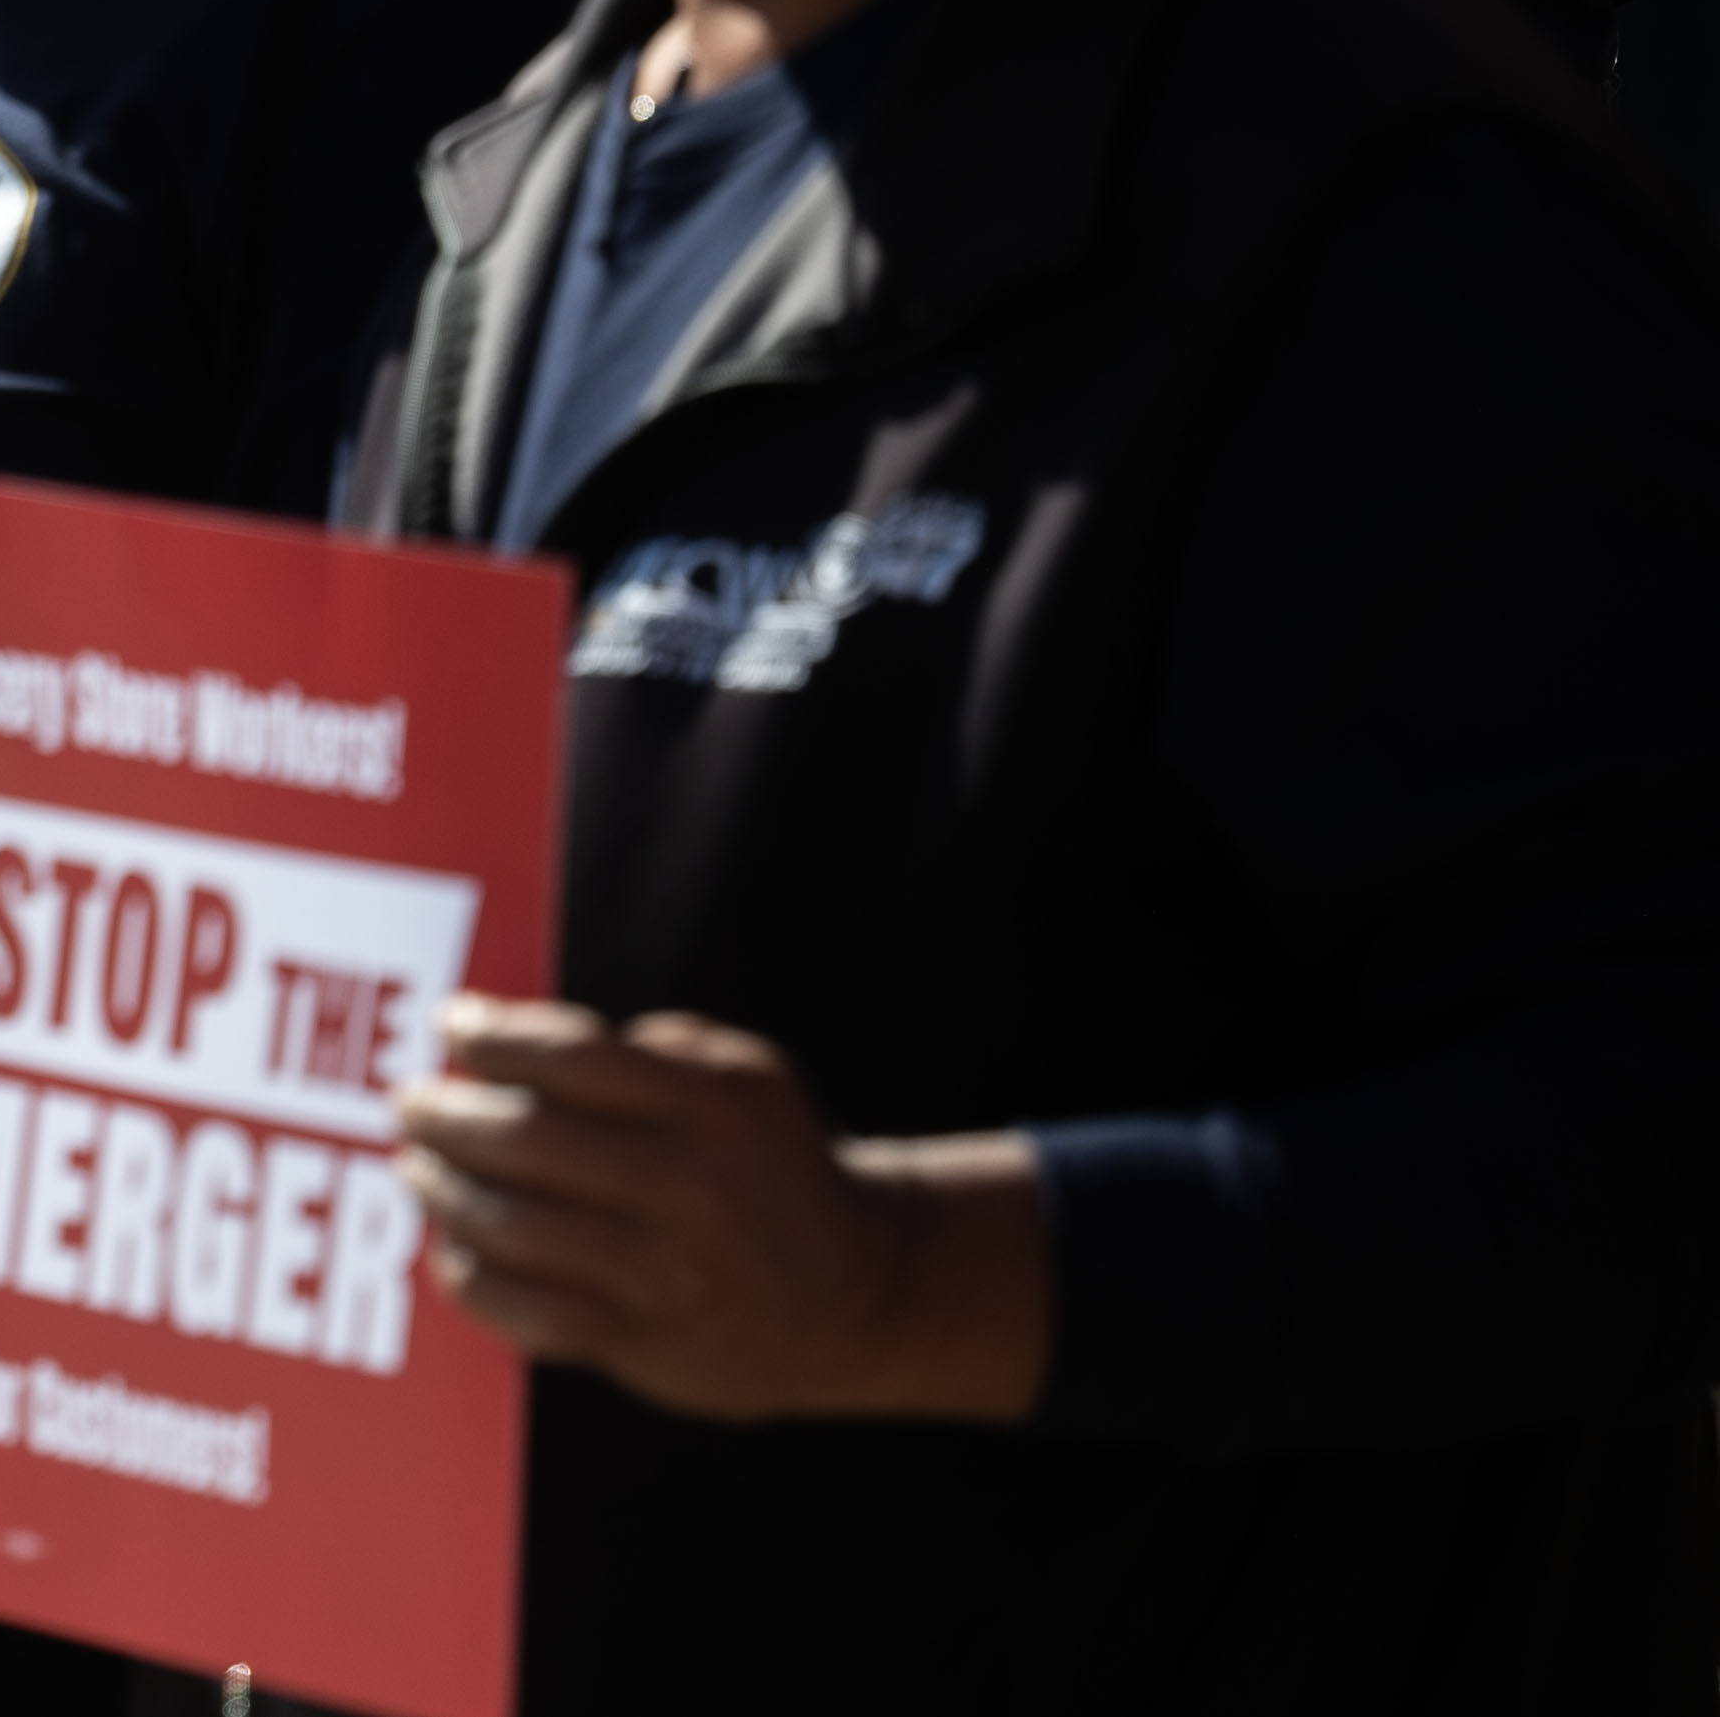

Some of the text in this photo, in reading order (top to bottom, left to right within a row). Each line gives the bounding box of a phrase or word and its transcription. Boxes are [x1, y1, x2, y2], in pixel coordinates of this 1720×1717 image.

[69, 647, 185, 767] Store
[187, 666, 409, 804] Workers!
[266, 959, 409, 1096] THE
[24, 1357, 272, 1508] Customers!
